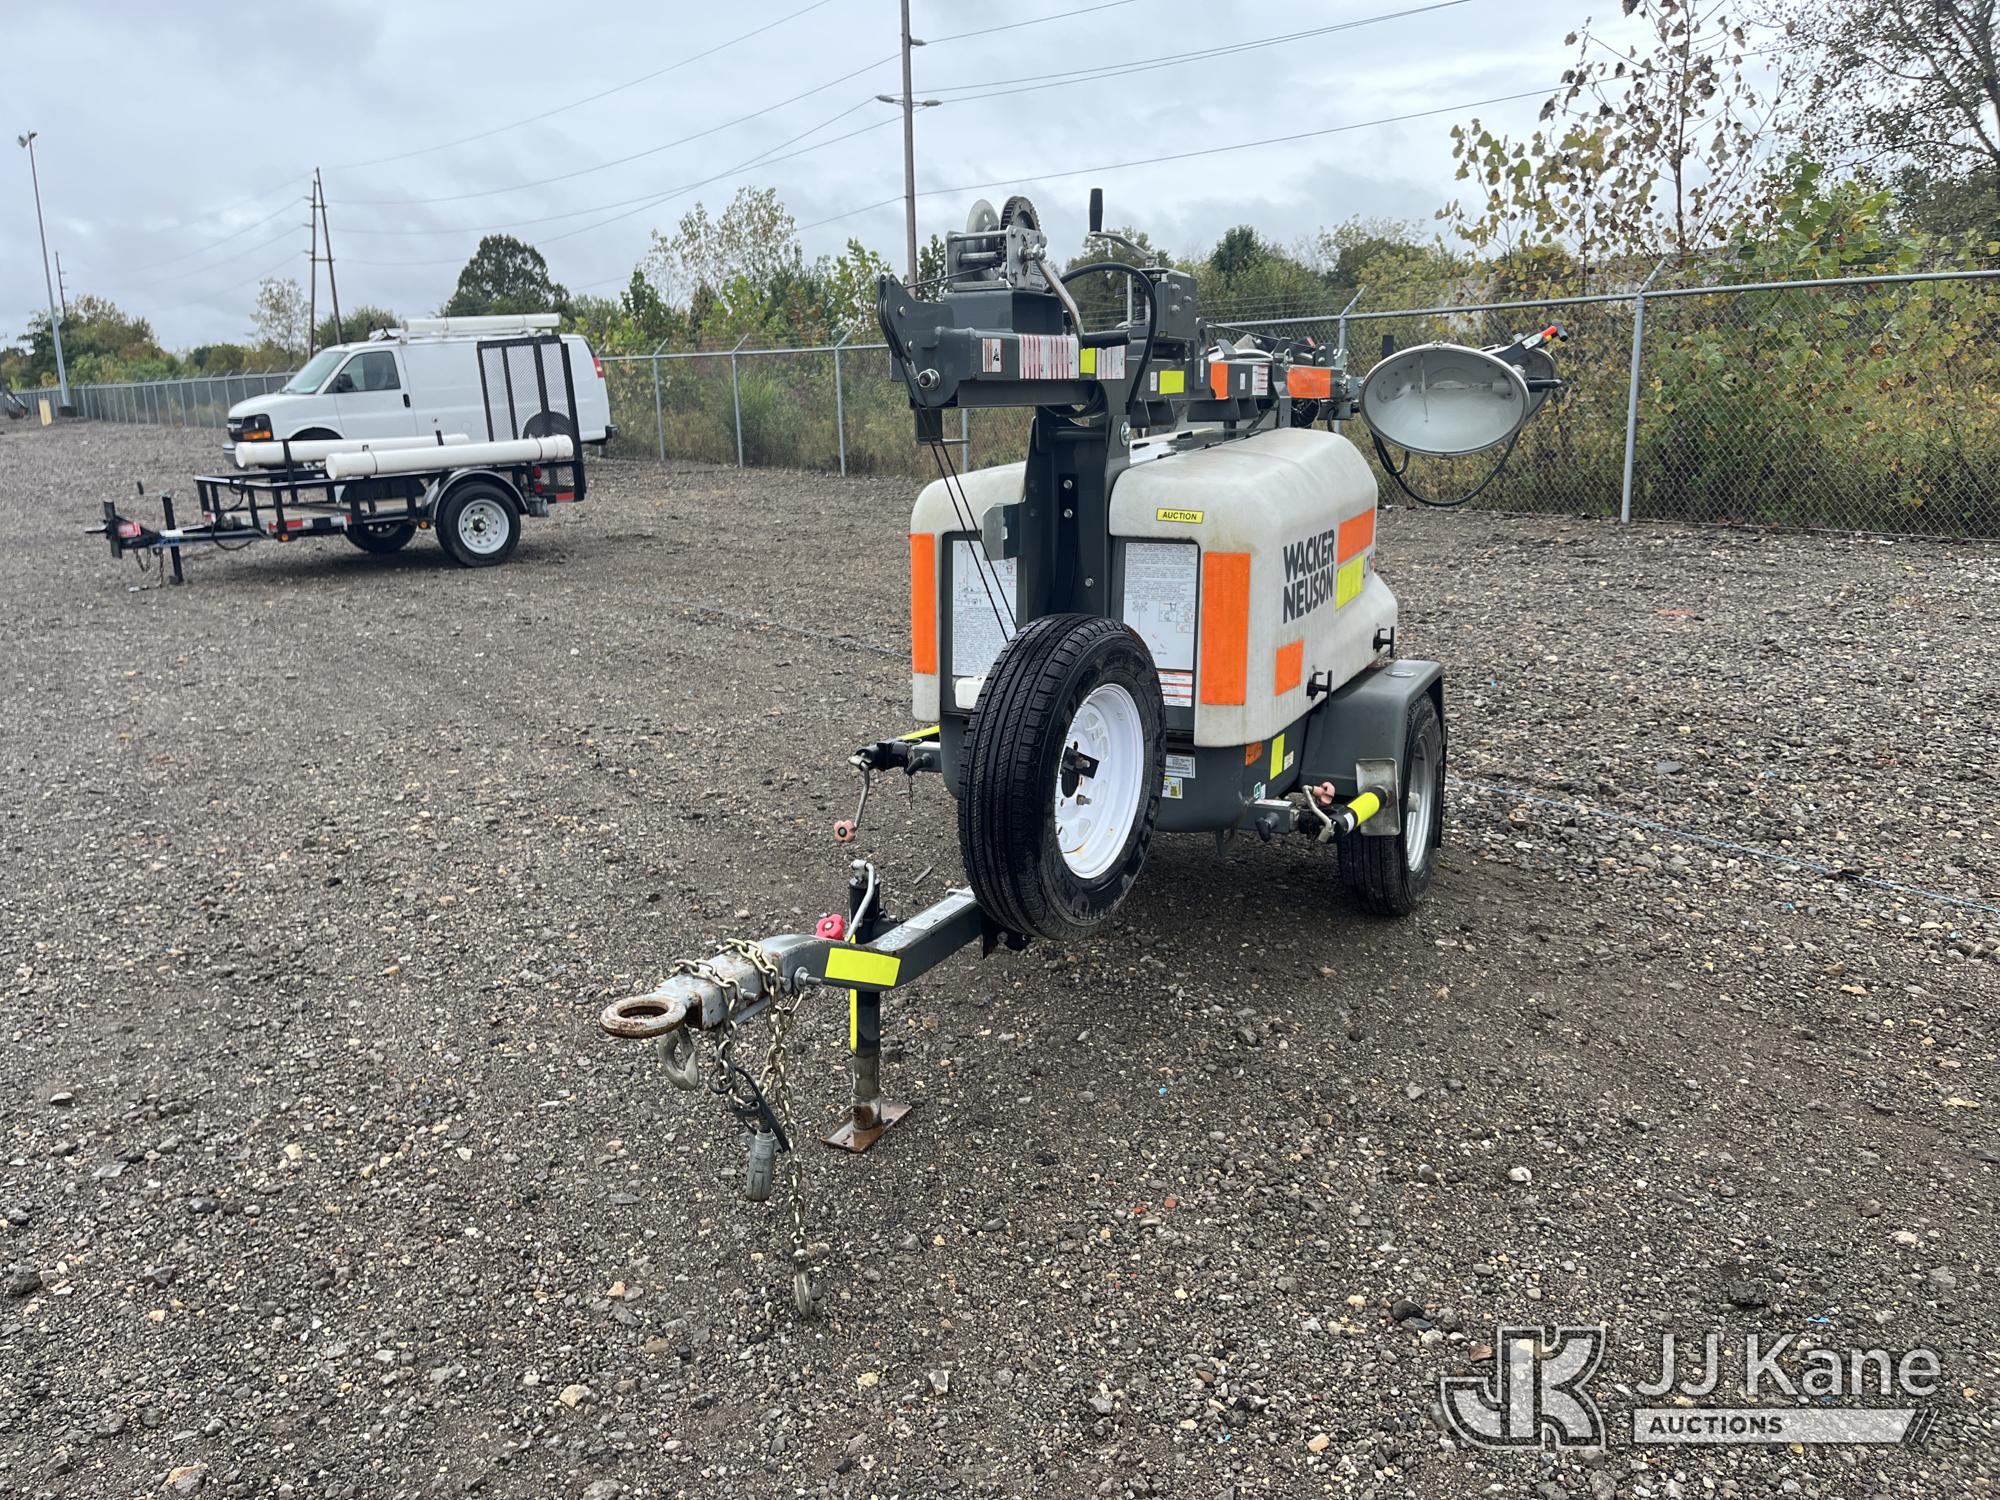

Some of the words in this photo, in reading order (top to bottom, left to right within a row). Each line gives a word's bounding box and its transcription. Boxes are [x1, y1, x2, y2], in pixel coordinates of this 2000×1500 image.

[1162, 511, 1197, 520] AUCTION
[1283, 529, 1335, 583] WACKER
[1283, 563, 1334, 624] NEUSON
